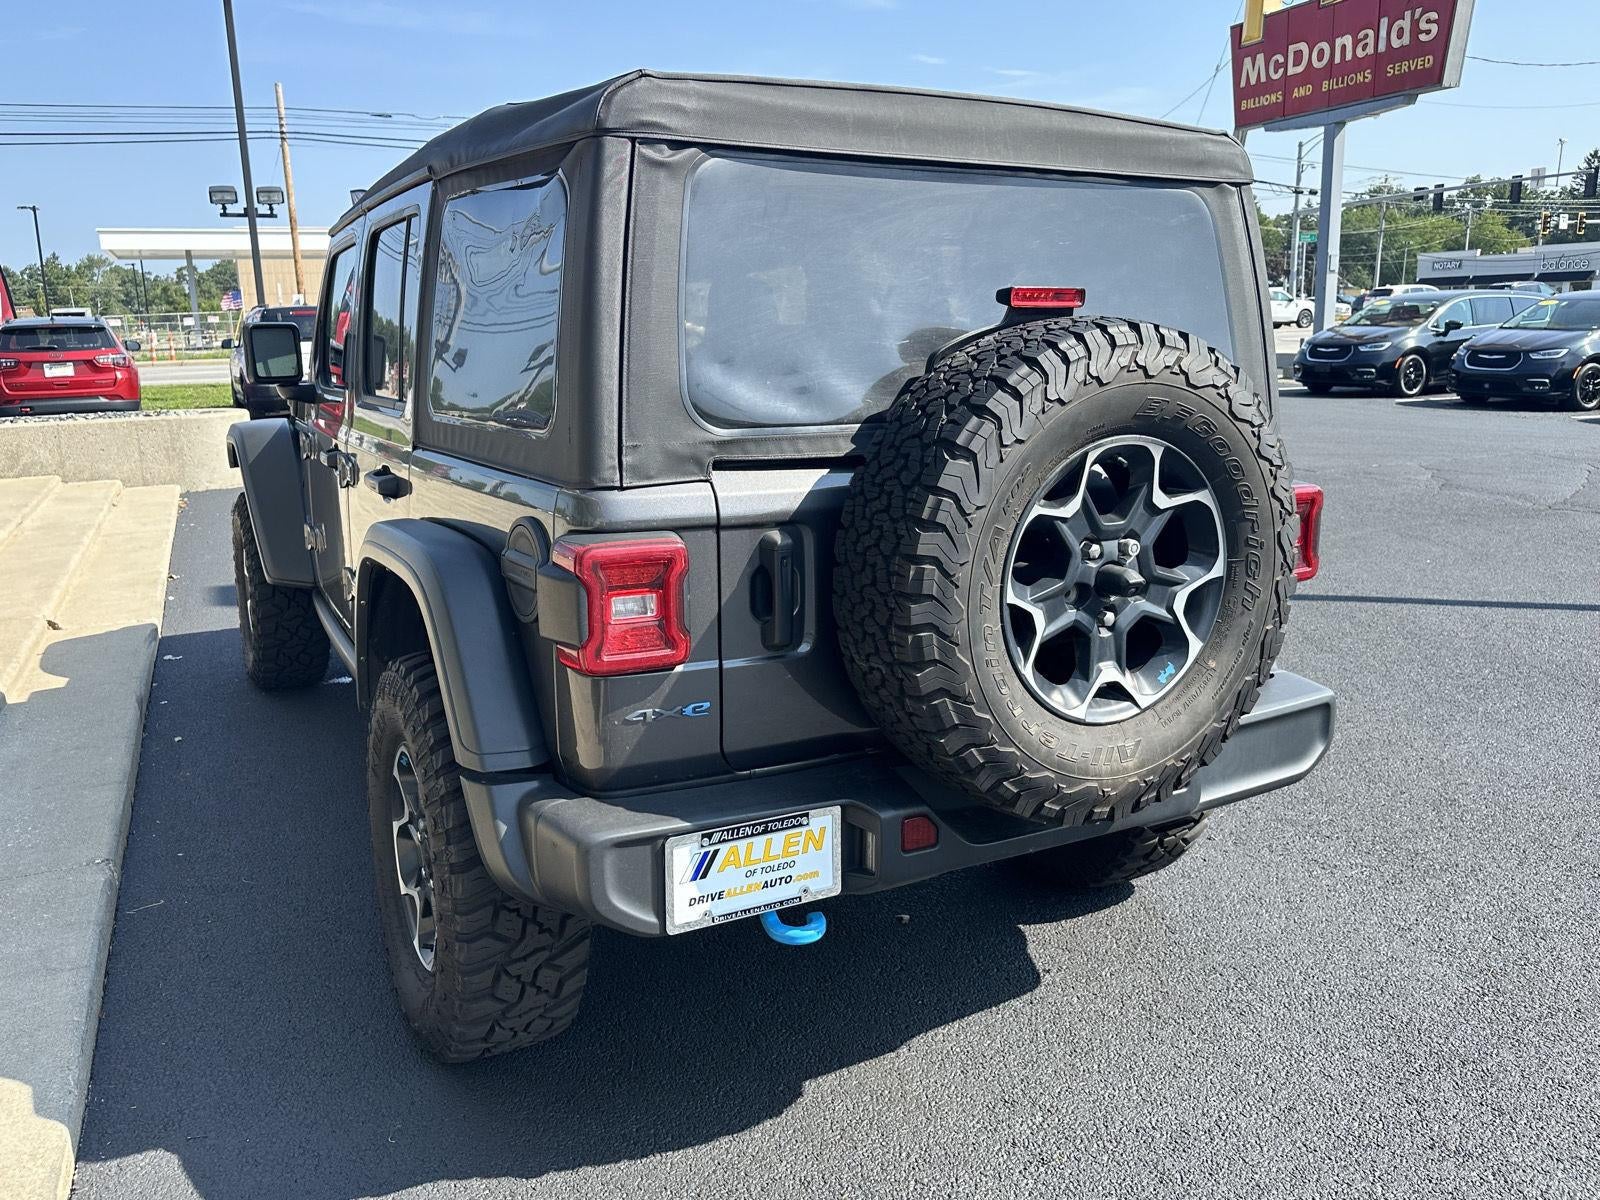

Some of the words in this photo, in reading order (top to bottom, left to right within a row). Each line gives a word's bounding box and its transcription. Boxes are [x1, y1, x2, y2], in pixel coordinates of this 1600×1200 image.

[1240, 7, 1439, 88] McDonald's
[1241, 90, 1283, 111] BILLIONS
[1292, 84, 1313, 100] AND
[1322, 69, 1373, 93] BILLIONS
[1386, 55, 1434, 78] SERVED
[1433, 260, 1461, 271] NOTARY
[1540, 254, 1590, 271] balance
[720, 826, 752, 842] ALLEN
[753, 823, 765, 834] OF
[767, 817, 801, 832] TOLEDO
[717, 827, 827, 873] ALLEN
[744, 868, 759, 879] OF
[760, 860, 796, 875] TOLEDO
[688, 870, 820, 907] DRIVEALLENAUTO.com
